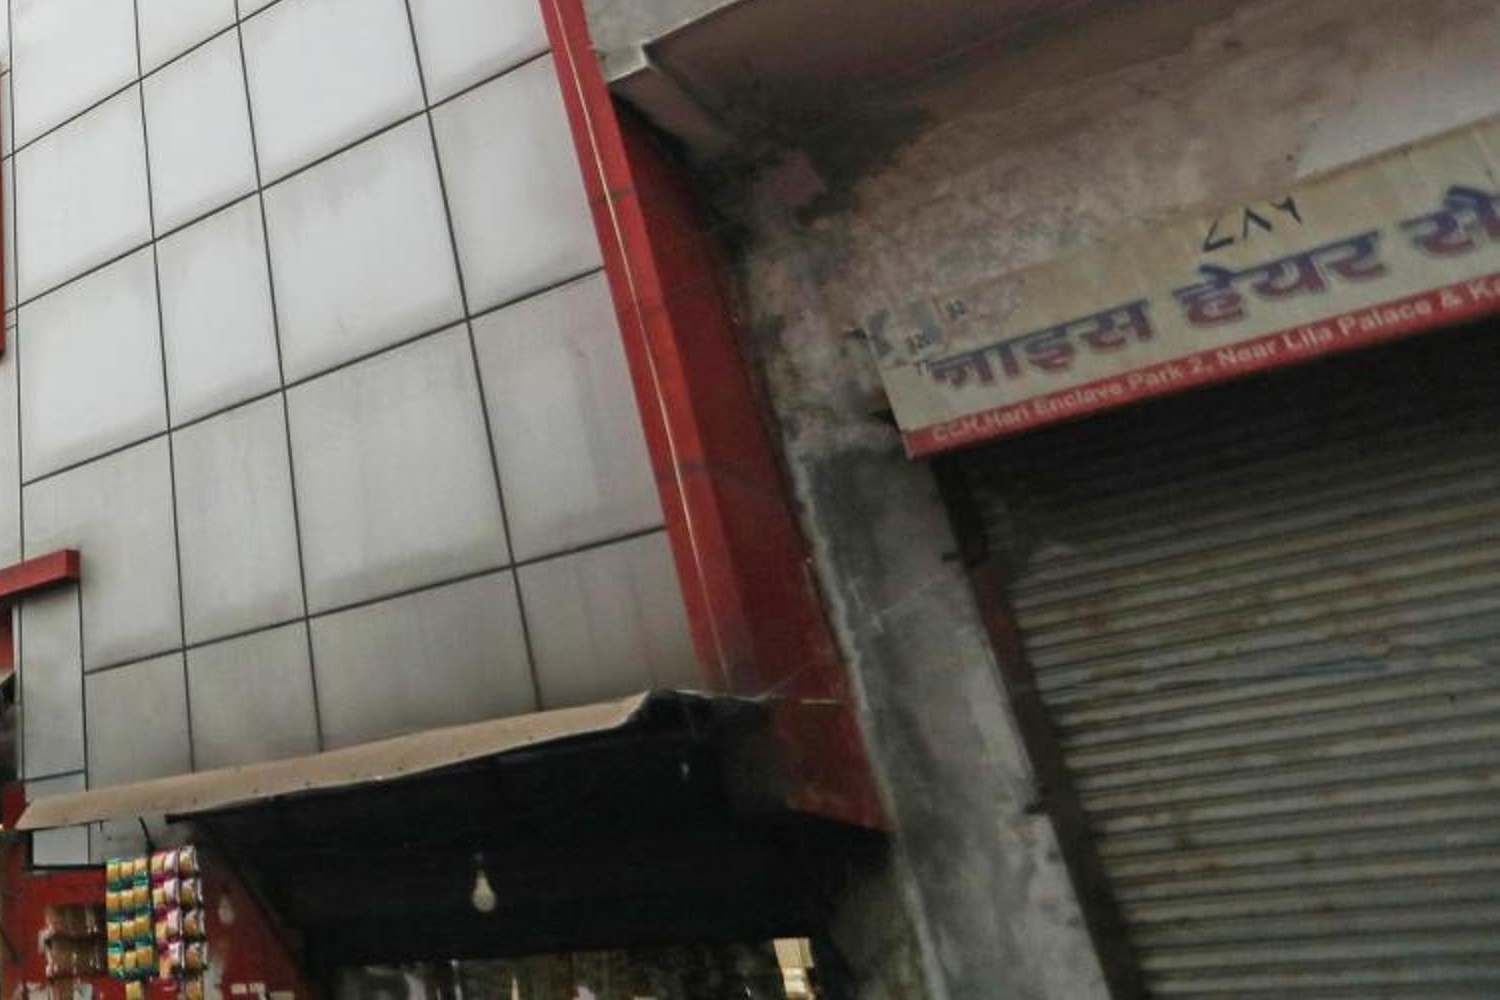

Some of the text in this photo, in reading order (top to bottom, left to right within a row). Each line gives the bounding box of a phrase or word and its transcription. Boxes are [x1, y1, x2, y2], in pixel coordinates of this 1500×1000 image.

[1171, 230, 1386, 328] हेयर
[1126, 364, 1184, 391] Park
[1217, 340, 1277, 366] Near
[1336, 301, 1432, 336] Palace
[1440, 290, 1463, 309] &
